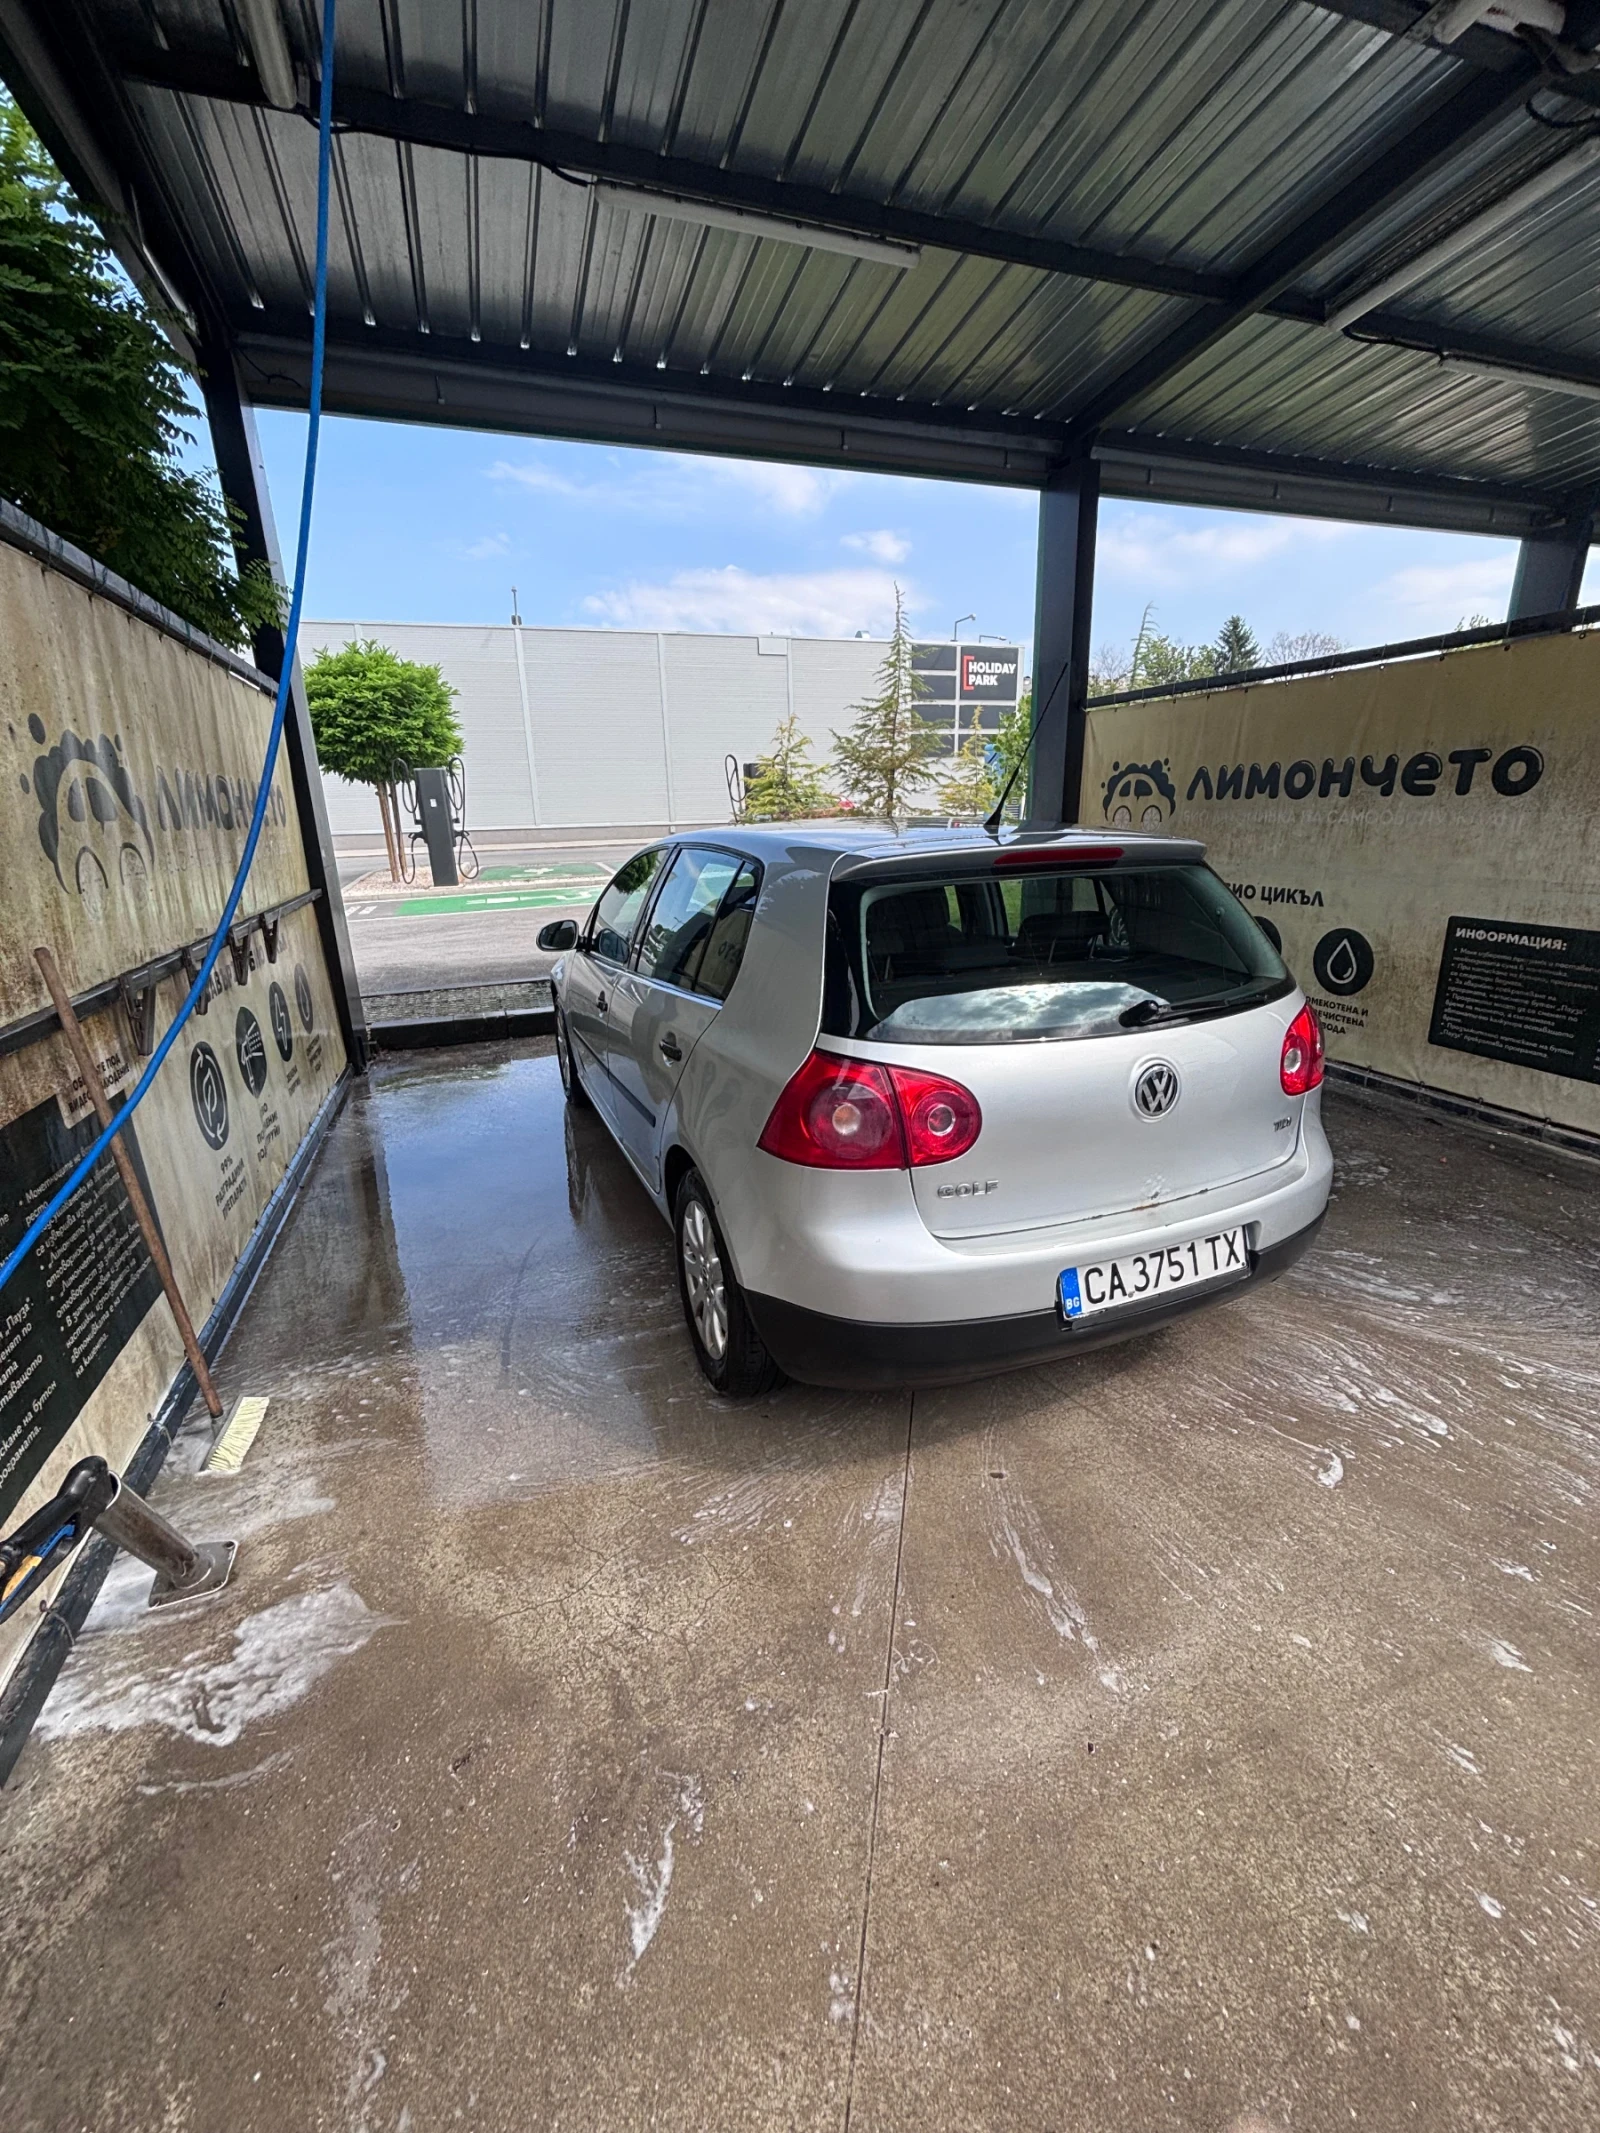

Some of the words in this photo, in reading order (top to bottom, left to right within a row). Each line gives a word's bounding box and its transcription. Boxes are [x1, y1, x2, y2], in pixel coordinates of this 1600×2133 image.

[969, 661, 1016, 674] HOLIDAY
[969, 674, 998, 686] PARK
[1261, 886, 1324, 907] ЦИКЪЛ
[1455, 927, 1567, 950] ИНФОРМАЦИЯ:
[1313, 1008, 1365, 1027] ЕЧИСТЕНА
[937, 1179, 999, 1200] GOLF
[1132, 1242, 1199, 1293] 3751
[1065, 1296, 1081, 1310] BG
